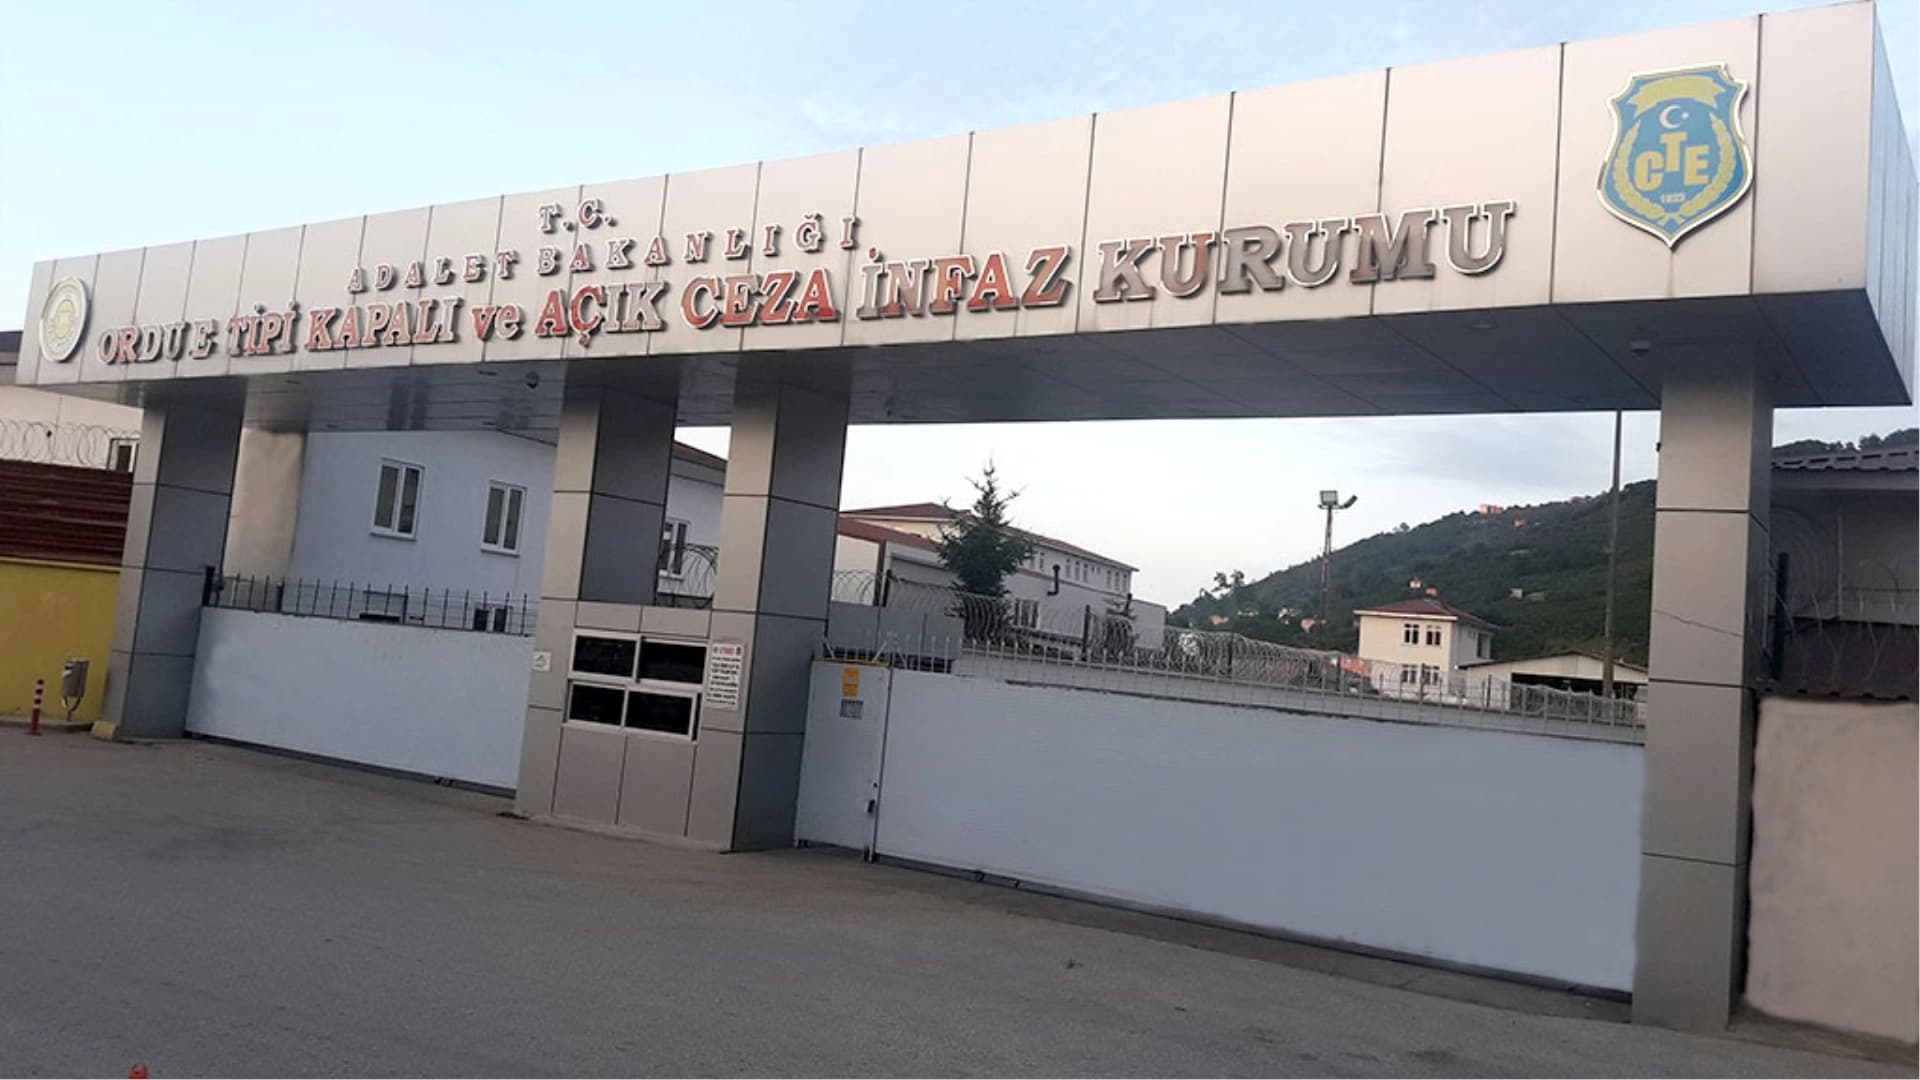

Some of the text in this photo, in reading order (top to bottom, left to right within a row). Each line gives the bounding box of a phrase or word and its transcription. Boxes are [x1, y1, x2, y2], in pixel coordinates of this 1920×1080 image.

[1634, 131, 1709, 191] CTE
[538, 199, 614, 232] T.C.
[98, 200, 1516, 364] ORDU E TİPİ KAPALI ve AÇIK CEZA İNFAZ KURUMU
[348, 211, 859, 292] ADALET BAKANLIĞI
